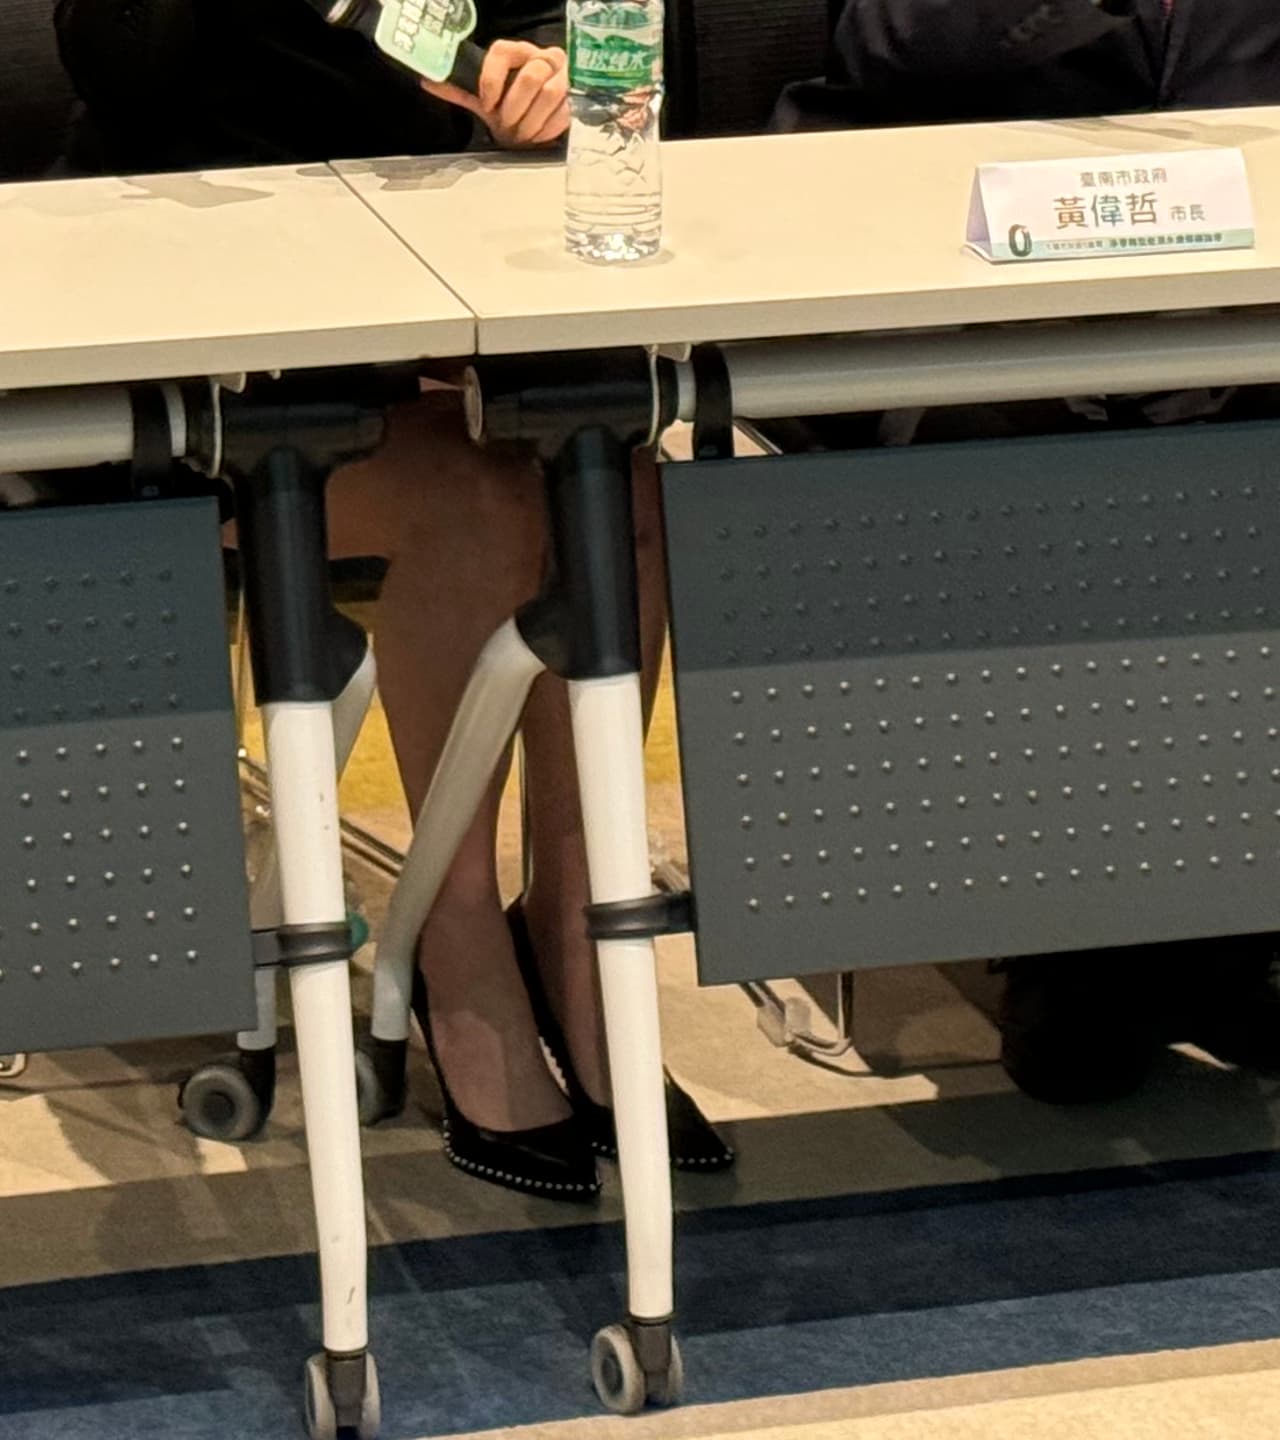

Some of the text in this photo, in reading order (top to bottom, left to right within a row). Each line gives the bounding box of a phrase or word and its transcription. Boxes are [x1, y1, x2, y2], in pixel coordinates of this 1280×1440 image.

[1079, 166, 1168, 189] 臺南市政府
[1052, 191, 1206, 230] 黃偉哲 市長
